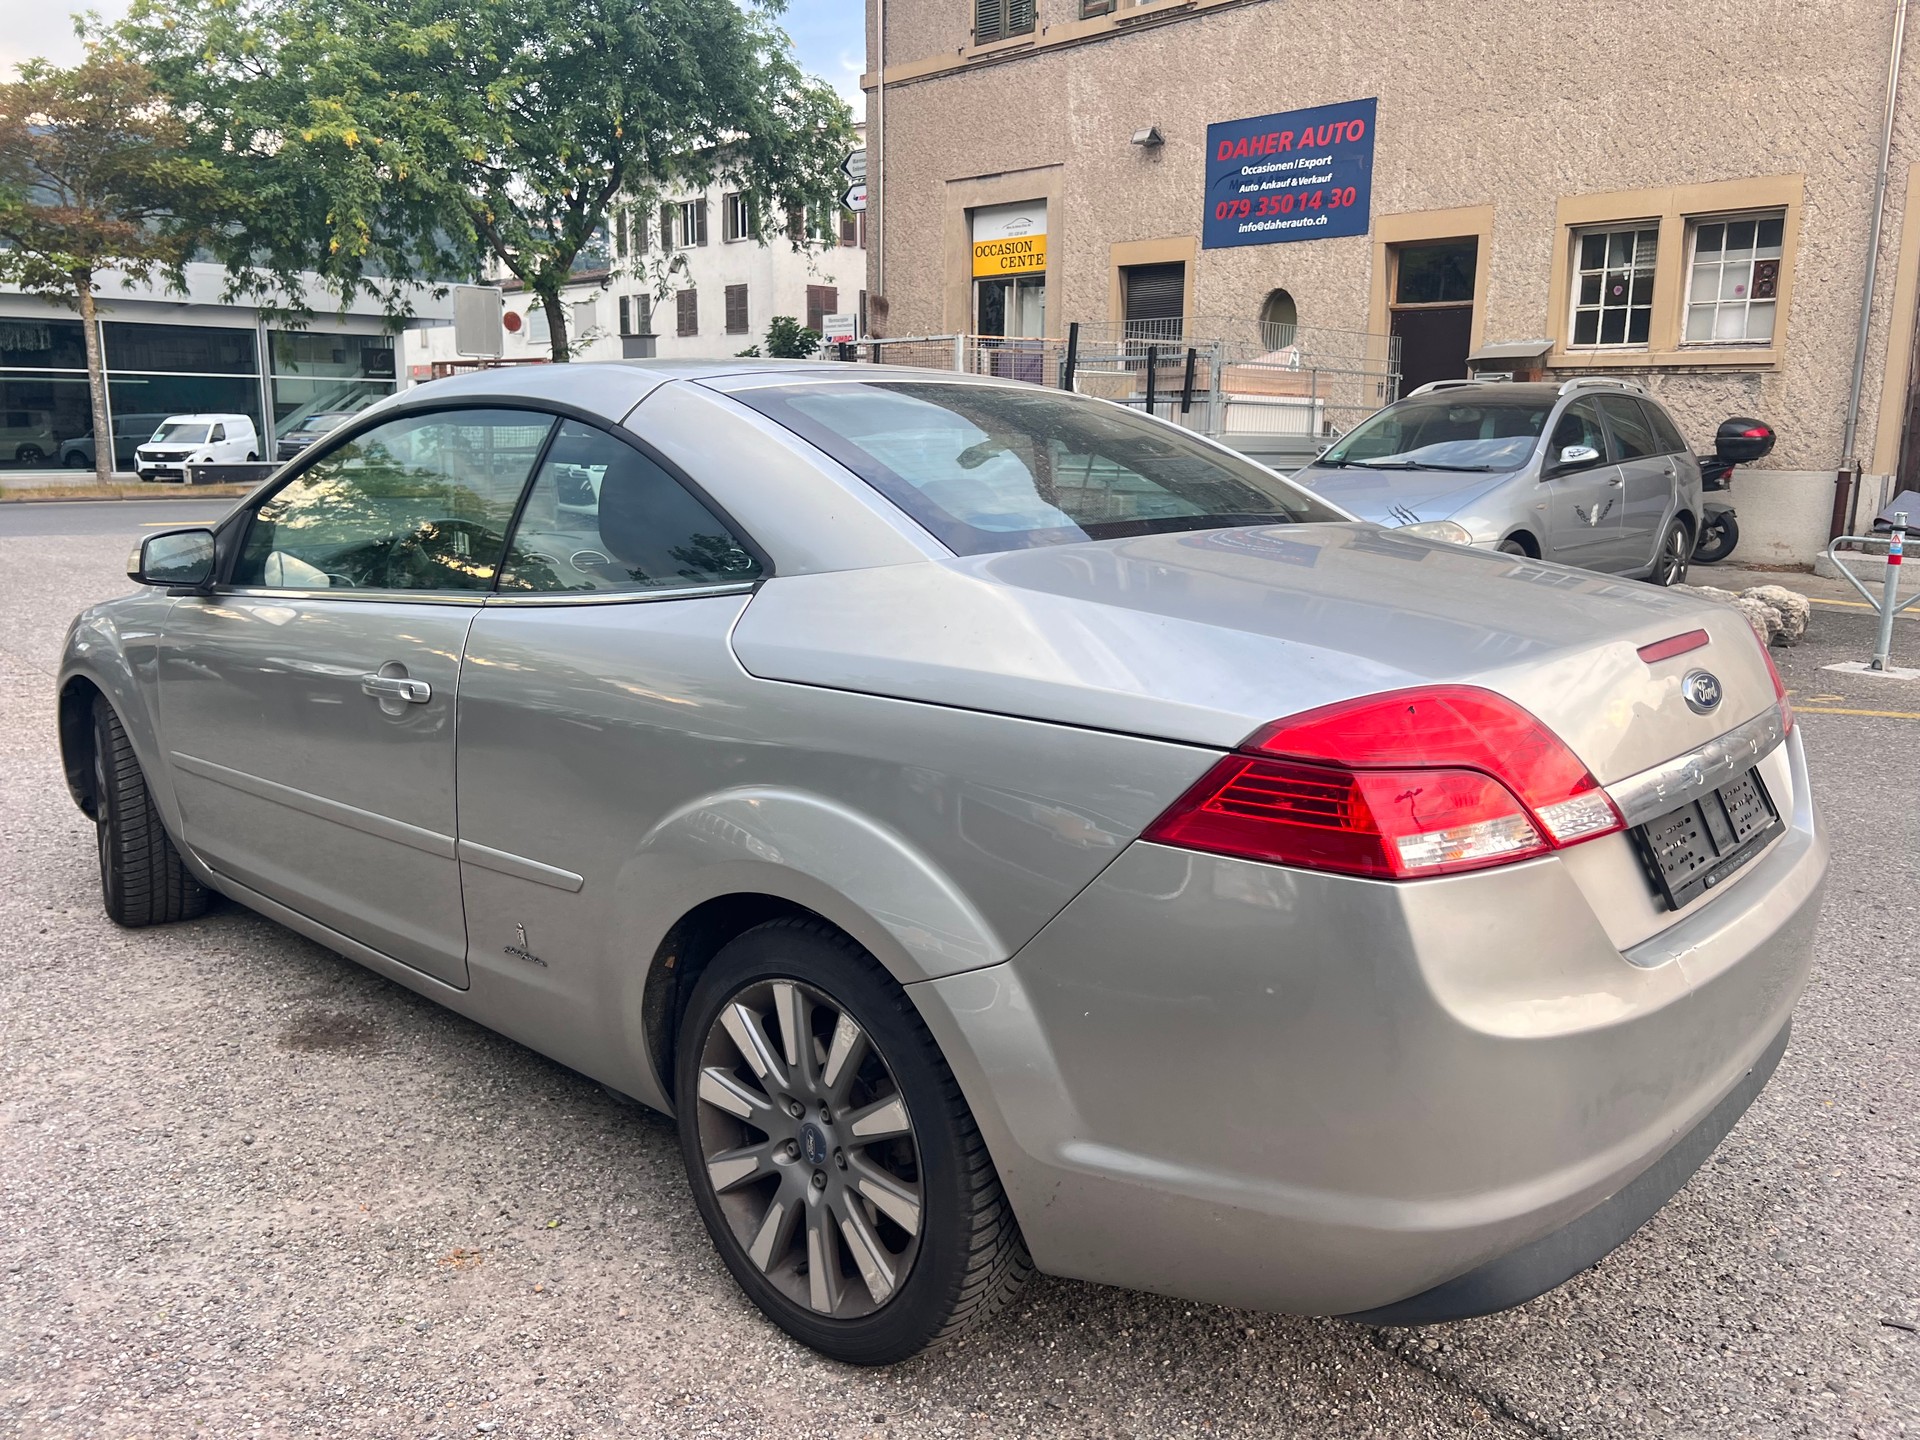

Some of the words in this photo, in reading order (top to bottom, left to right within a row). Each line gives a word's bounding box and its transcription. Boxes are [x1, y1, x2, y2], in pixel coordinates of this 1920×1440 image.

[1217, 131, 1294, 161] DAHER
[1297, 119, 1365, 149] AUTO
[1238, 184, 1259, 193] Auto
[1260, 178, 1292, 190] Ankauf
[1298, 173, 1333, 187] Verkauf
[1215, 199, 1251, 220] 079
[1256, 194, 1294, 216] 350
[1298, 190, 1323, 211] 14
[1328, 186, 1356, 209] 30
[1238, 214, 1328, 233] info@daherauto.ch
[975, 240, 1033, 258] OCCASION
[1000, 253, 1047, 269] CENTE
